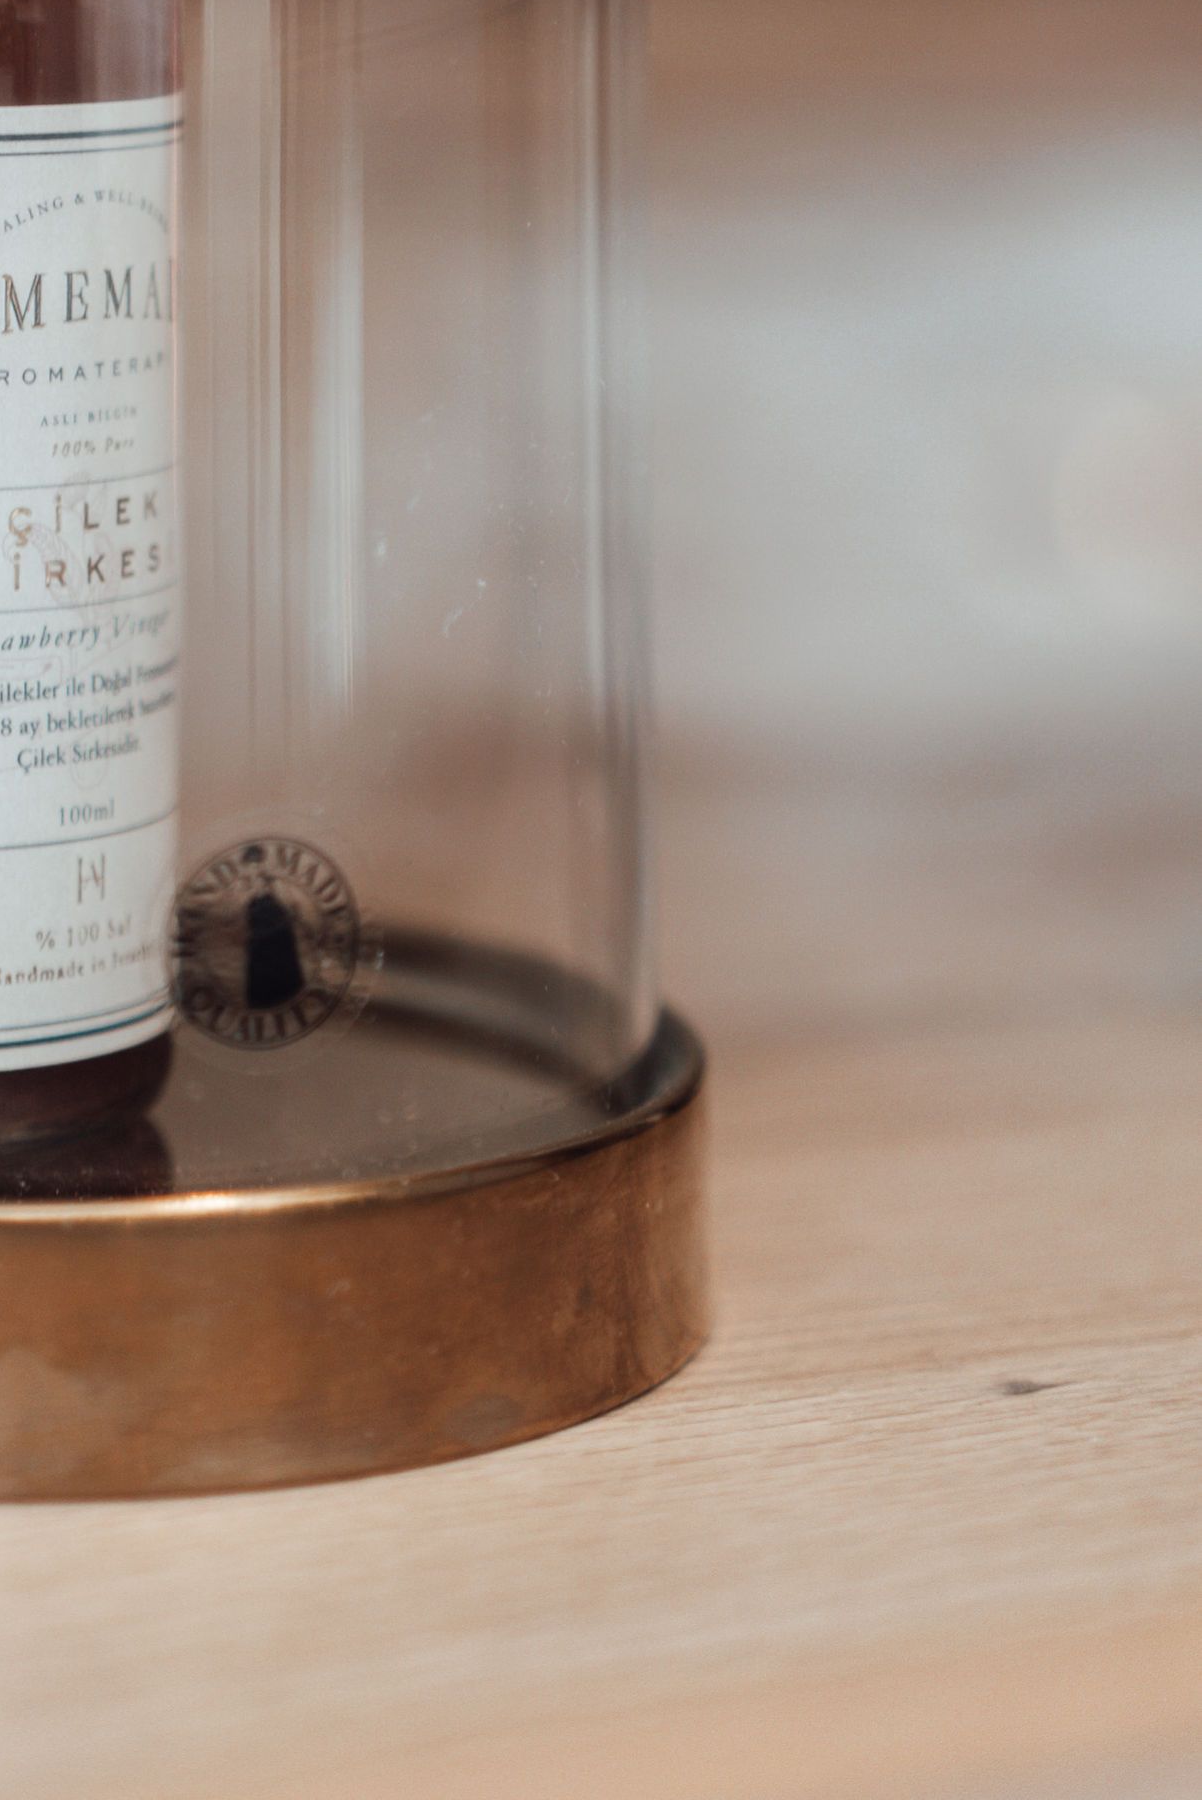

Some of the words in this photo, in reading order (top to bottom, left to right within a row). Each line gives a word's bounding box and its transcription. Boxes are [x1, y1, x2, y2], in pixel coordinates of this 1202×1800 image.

[74, 192, 86, 205] &
[8, 488, 159, 546] ÇİLEK
[66, 676, 85, 698] ile
[0, 720, 13, 737] 8
[19, 720, 41, 740] ay
[17, 743, 66, 773] Çilek
[58, 798, 115, 826] 100ml
